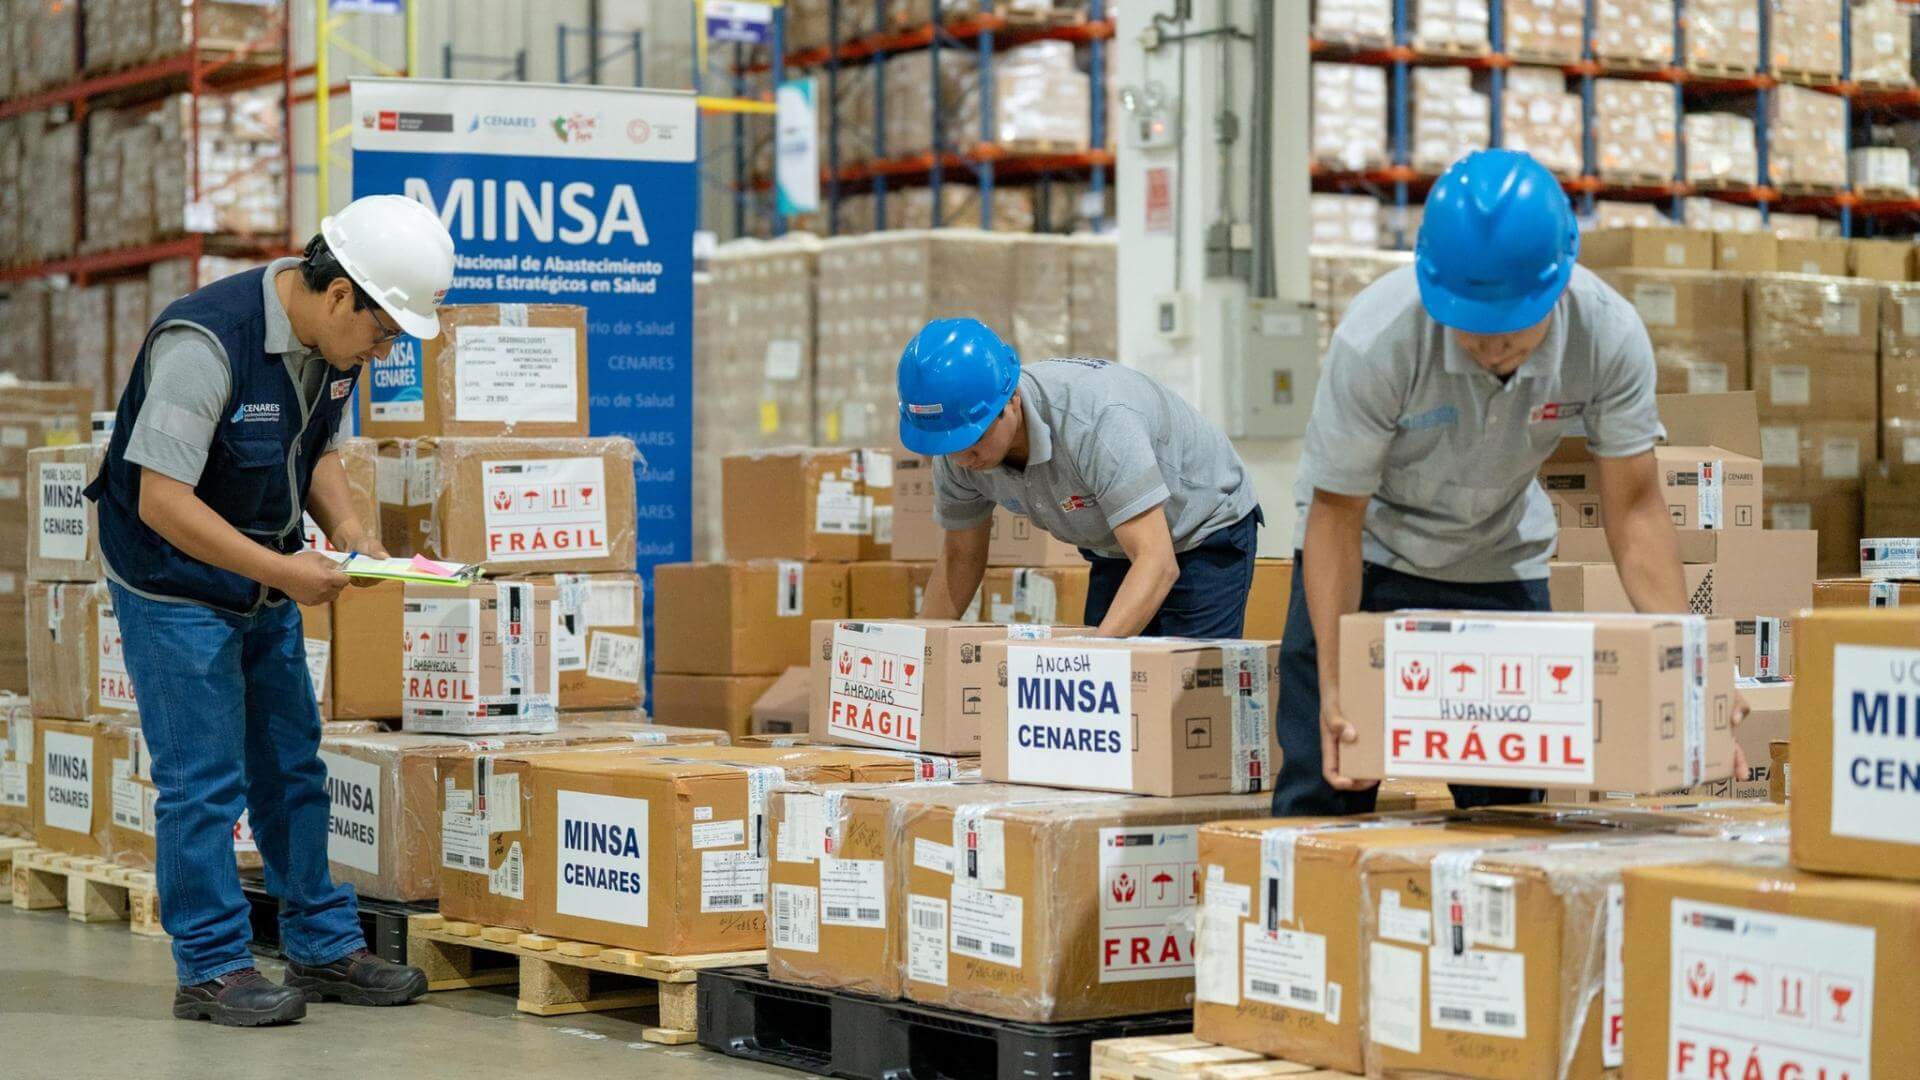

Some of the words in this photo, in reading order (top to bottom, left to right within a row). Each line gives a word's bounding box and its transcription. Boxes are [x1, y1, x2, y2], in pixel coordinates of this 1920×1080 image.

[483, 115, 537, 129] CENARES
[404, 178, 649, 246] MINSA
[454, 255, 517, 271] Nacional
[521, 257, 541, 271] de
[544, 257, 663, 275] Abastecimiento
[496, 275, 587, 294] Estratégicos
[591, 280, 611, 292] en
[613, 278, 657, 293] Salud
[613, 321, 632, 335] de
[635, 322, 675, 336] Salud
[608, 356, 675, 370] CENARES
[374, 369, 416, 387] CENARES
[243, 403, 280, 412] CENARES
[613, 394, 632, 408] de
[635, 394, 675, 408] Salud
[1728, 473, 1754, 481] CENARES
[44, 484, 83, 508] MINSA
[44, 517, 84, 536] CENARES
[490, 527, 602, 552] FRÁGIL
[1035, 654, 1091, 674] ANCASH
[403, 674, 474, 700] RÁGIL
[844, 682, 895, 706] AMAZONAS
[1017, 677, 1120, 715] MINSA
[832, 703, 917, 741] FRÁGIL
[1439, 698, 1531, 722] HUANUCO
[1017, 724, 1122, 754] CENARES
[1392, 725, 1584, 764] FRÁGIL
[48, 753, 89, 782] MINSA
[48, 786, 89, 809] CENARES
[1736, 788, 1768, 799] Instituto
[328, 815, 375, 845] ENARES
[564, 819, 640, 859] MINSA
[564, 862, 641, 894] CENARES
[1105, 929, 1195, 966] FRÁ
